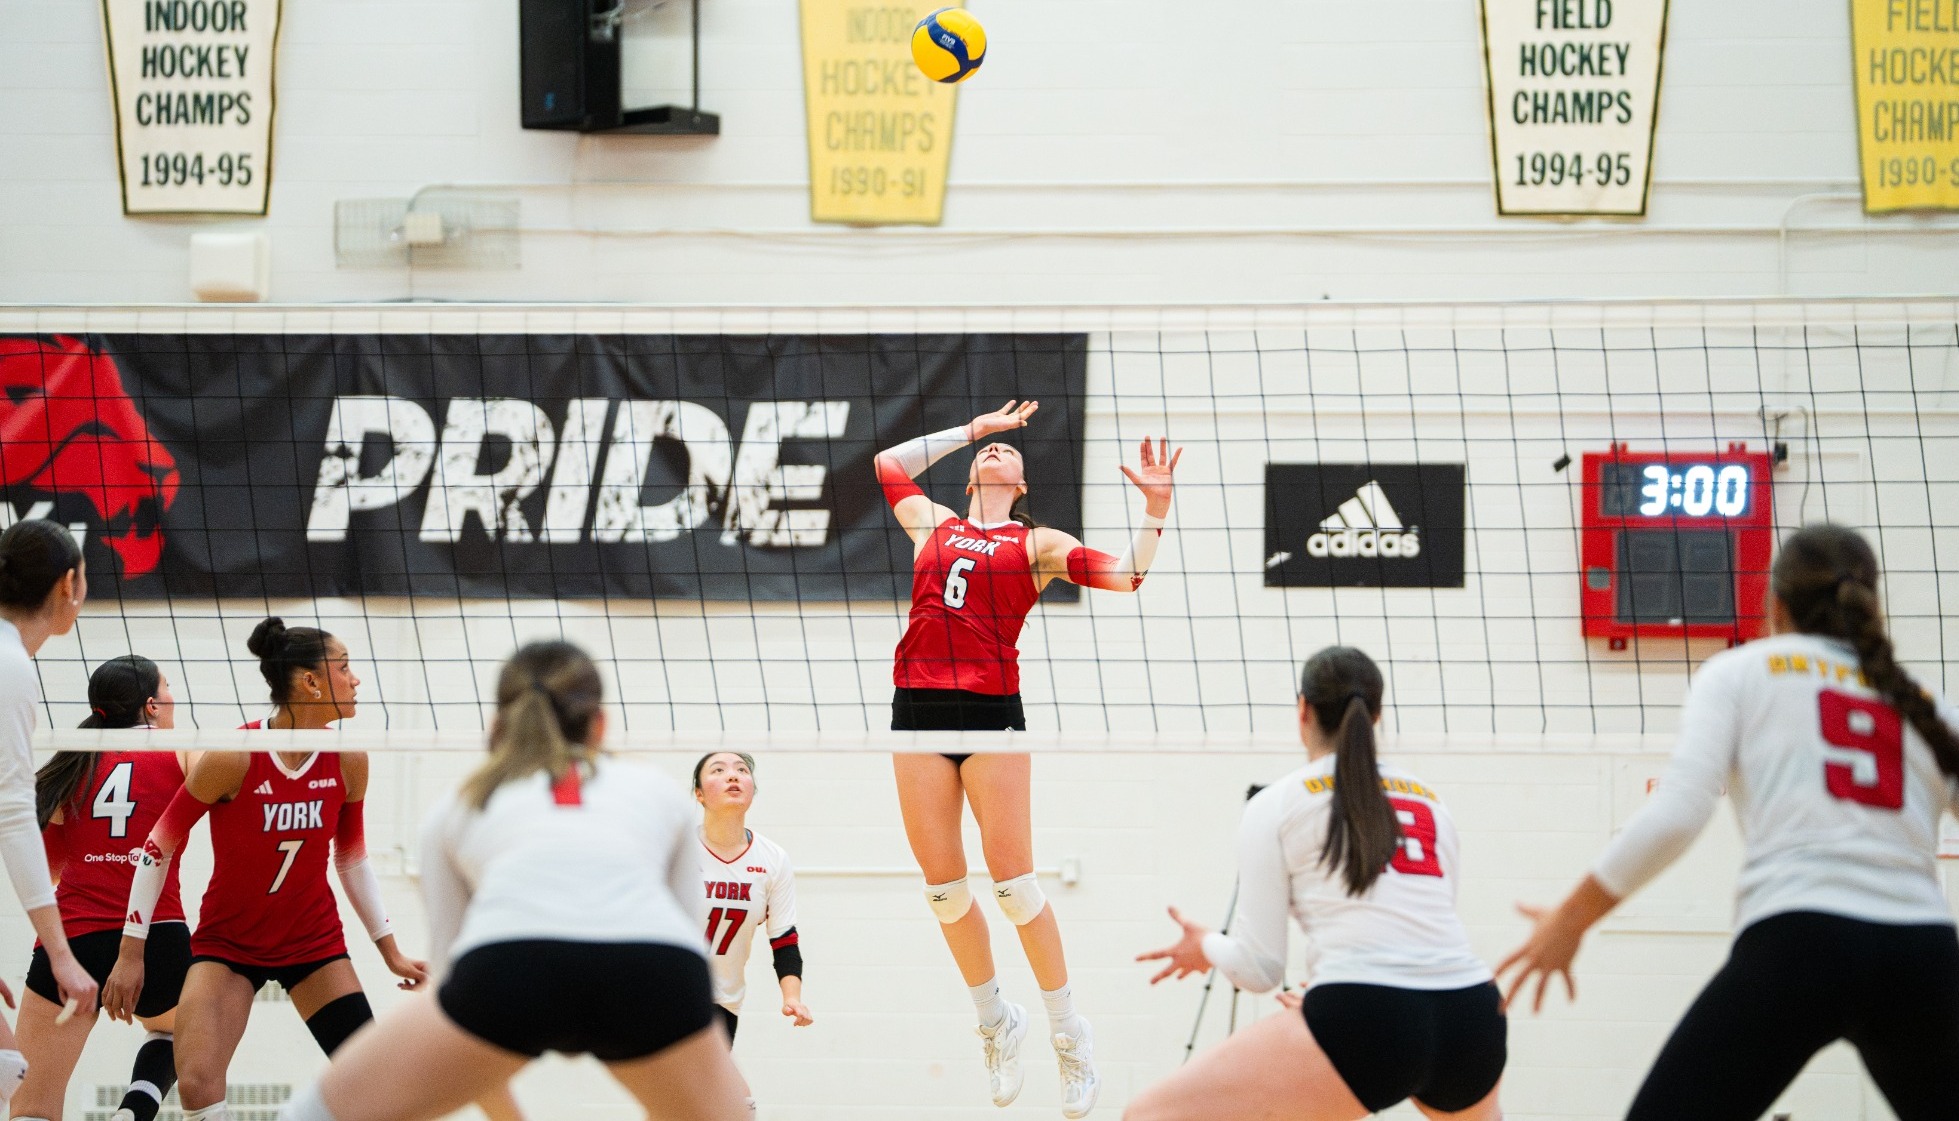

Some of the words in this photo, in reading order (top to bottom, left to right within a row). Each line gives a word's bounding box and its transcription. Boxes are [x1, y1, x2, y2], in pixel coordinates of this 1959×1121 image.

[145, 0, 247, 32] INDOOR
[1536, 0, 1612, 29] FIELD
[141, 45, 249, 78] HOCKEY
[1520, 42, 1631, 76] HOCKEY
[1870, 48, 1959, 84] HOCKE
[136, 92, 252, 126] CHAMPS
[1513, 90, 1632, 124] CHAMPS
[1873, 100, 1959, 142] CHAMP
[826, 111, 935, 152] CHAMPS
[140, 152, 253, 186] 1994-95
[1515, 152, 1632, 186] 1994-95
[1879, 157, 1959, 187] 1990-9
[305, 395, 850, 547] PRIDE
[1639, 464, 1749, 517] 3:00
[944, 533, 1001, 557] YORK
[1306, 528, 1421, 558] adidas
[942, 556, 977, 610] 6
[1817, 686, 1904, 810] 9
[92, 761, 137, 838] 4
[308, 777, 338, 789] OUA
[262, 799, 324, 832] YORK
[84, 853, 104, 863] One
[105, 852, 127, 865] Stop
[265, 839, 305, 895] 7
[703, 880, 752, 902] YORK
[704, 906, 749, 955] 17
